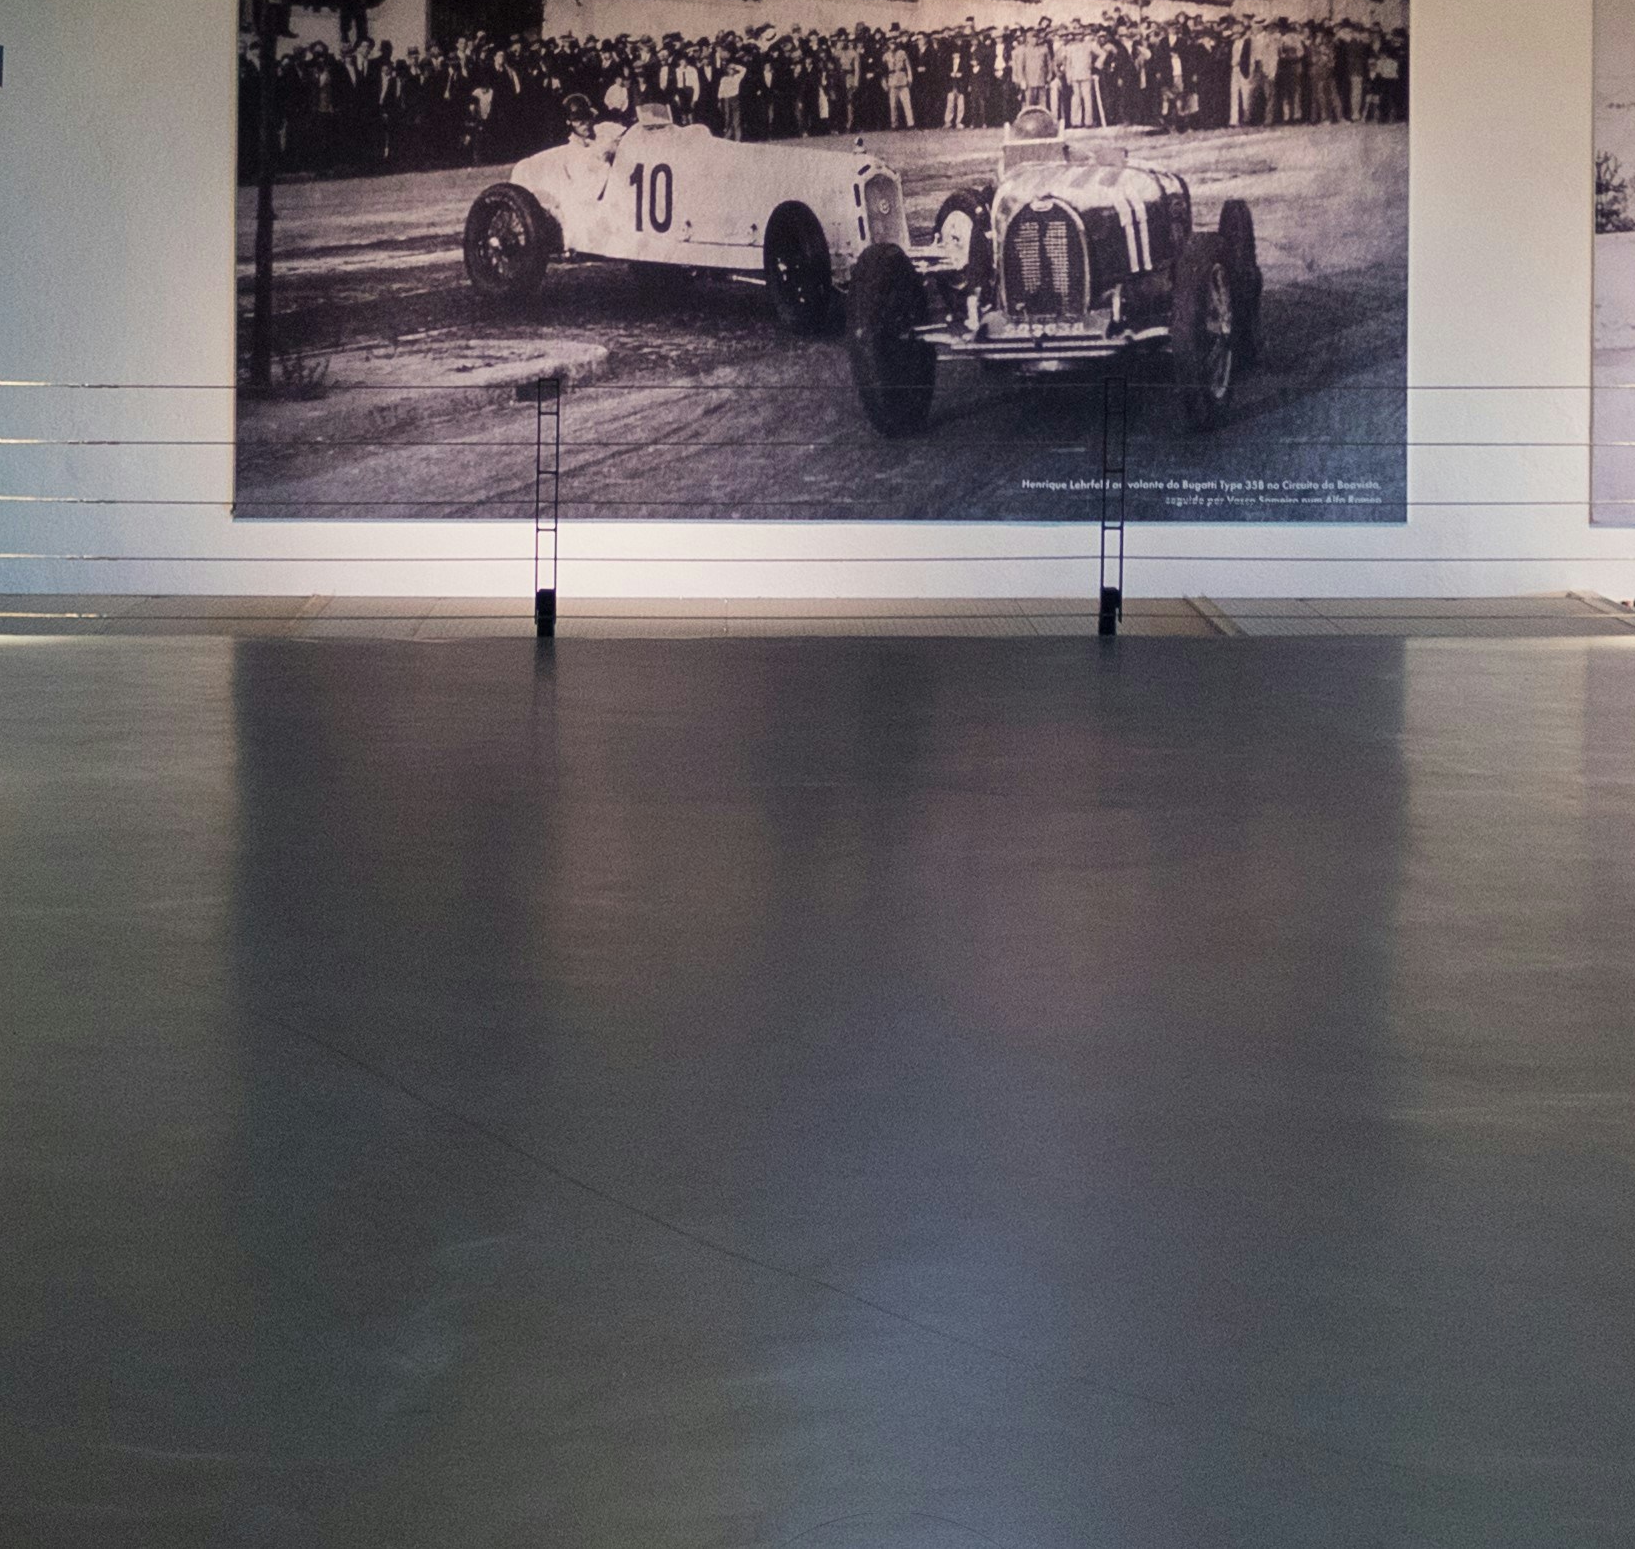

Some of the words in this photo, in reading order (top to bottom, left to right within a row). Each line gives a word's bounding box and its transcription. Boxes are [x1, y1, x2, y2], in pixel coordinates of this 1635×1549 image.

[629, 162, 674, 234] 10
[1021, 478, 1067, 492] Henrique
[1127, 479, 1165, 490] volante
[1166, 478, 1180, 490] do
[1182, 478, 1218, 492] Bugatti
[1219, 479, 1243, 493] Type
[1267, 481, 1280, 490] no
[1282, 479, 1319, 490] Circuito
[1321, 479, 1335, 490] da
[1206, 496, 1225, 507] por
[1325, 493, 1346, 504] Alfa
[1348, 493, 1383, 504] Romeo
